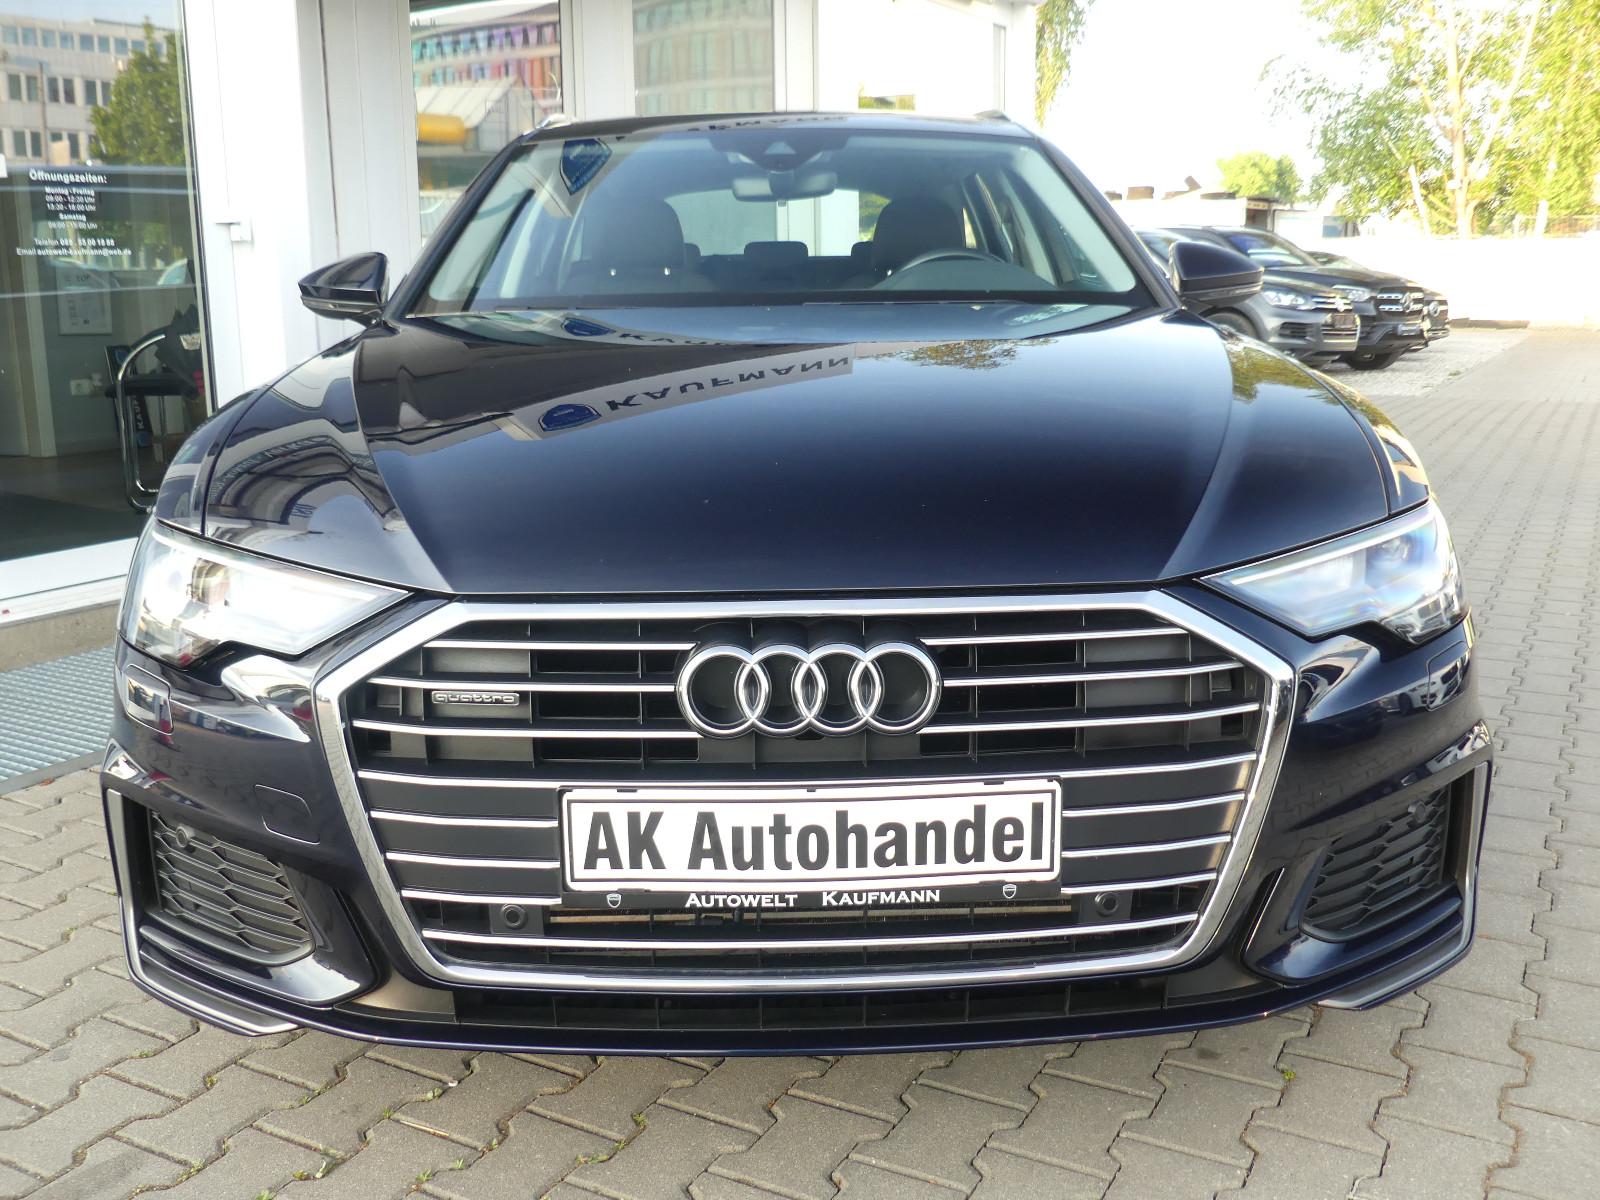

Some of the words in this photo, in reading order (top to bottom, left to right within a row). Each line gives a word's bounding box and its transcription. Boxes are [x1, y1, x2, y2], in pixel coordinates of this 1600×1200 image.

[29, 168, 107, 184] Öffnungszeiten:
[44, 186, 69, 196] Montag
[72, 187, 95, 197] Freitag
[59, 213, 86, 221] Samstag
[16, 247, 36, 255] Email
[435, 694, 514, 702] quattro
[584, 811, 666, 870] AK
[688, 802, 1044, 870] Autohandel
